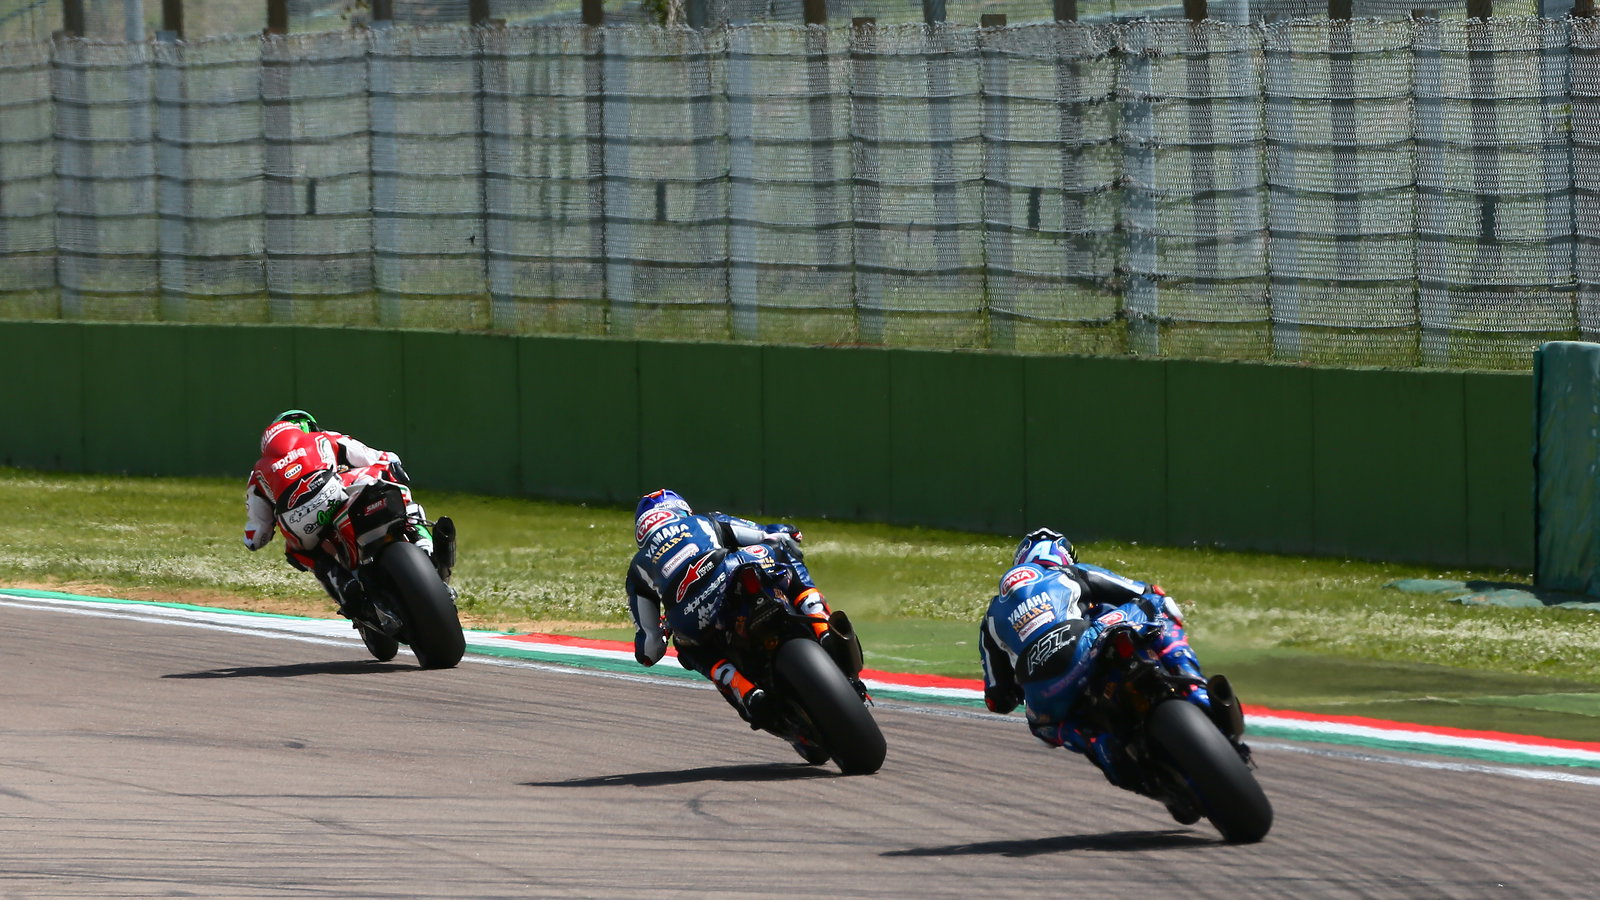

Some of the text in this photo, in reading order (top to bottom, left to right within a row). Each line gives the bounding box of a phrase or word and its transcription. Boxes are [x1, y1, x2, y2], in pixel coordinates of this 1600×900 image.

[271, 447, 308, 473] aprilia
[285, 464, 301, 477] Gulf
[638, 511, 668, 536] PATA
[645, 523, 690, 559] YAMAHA
[1003, 571, 1032, 591] PATA
[1007, 591, 1052, 626] YAMAHA
